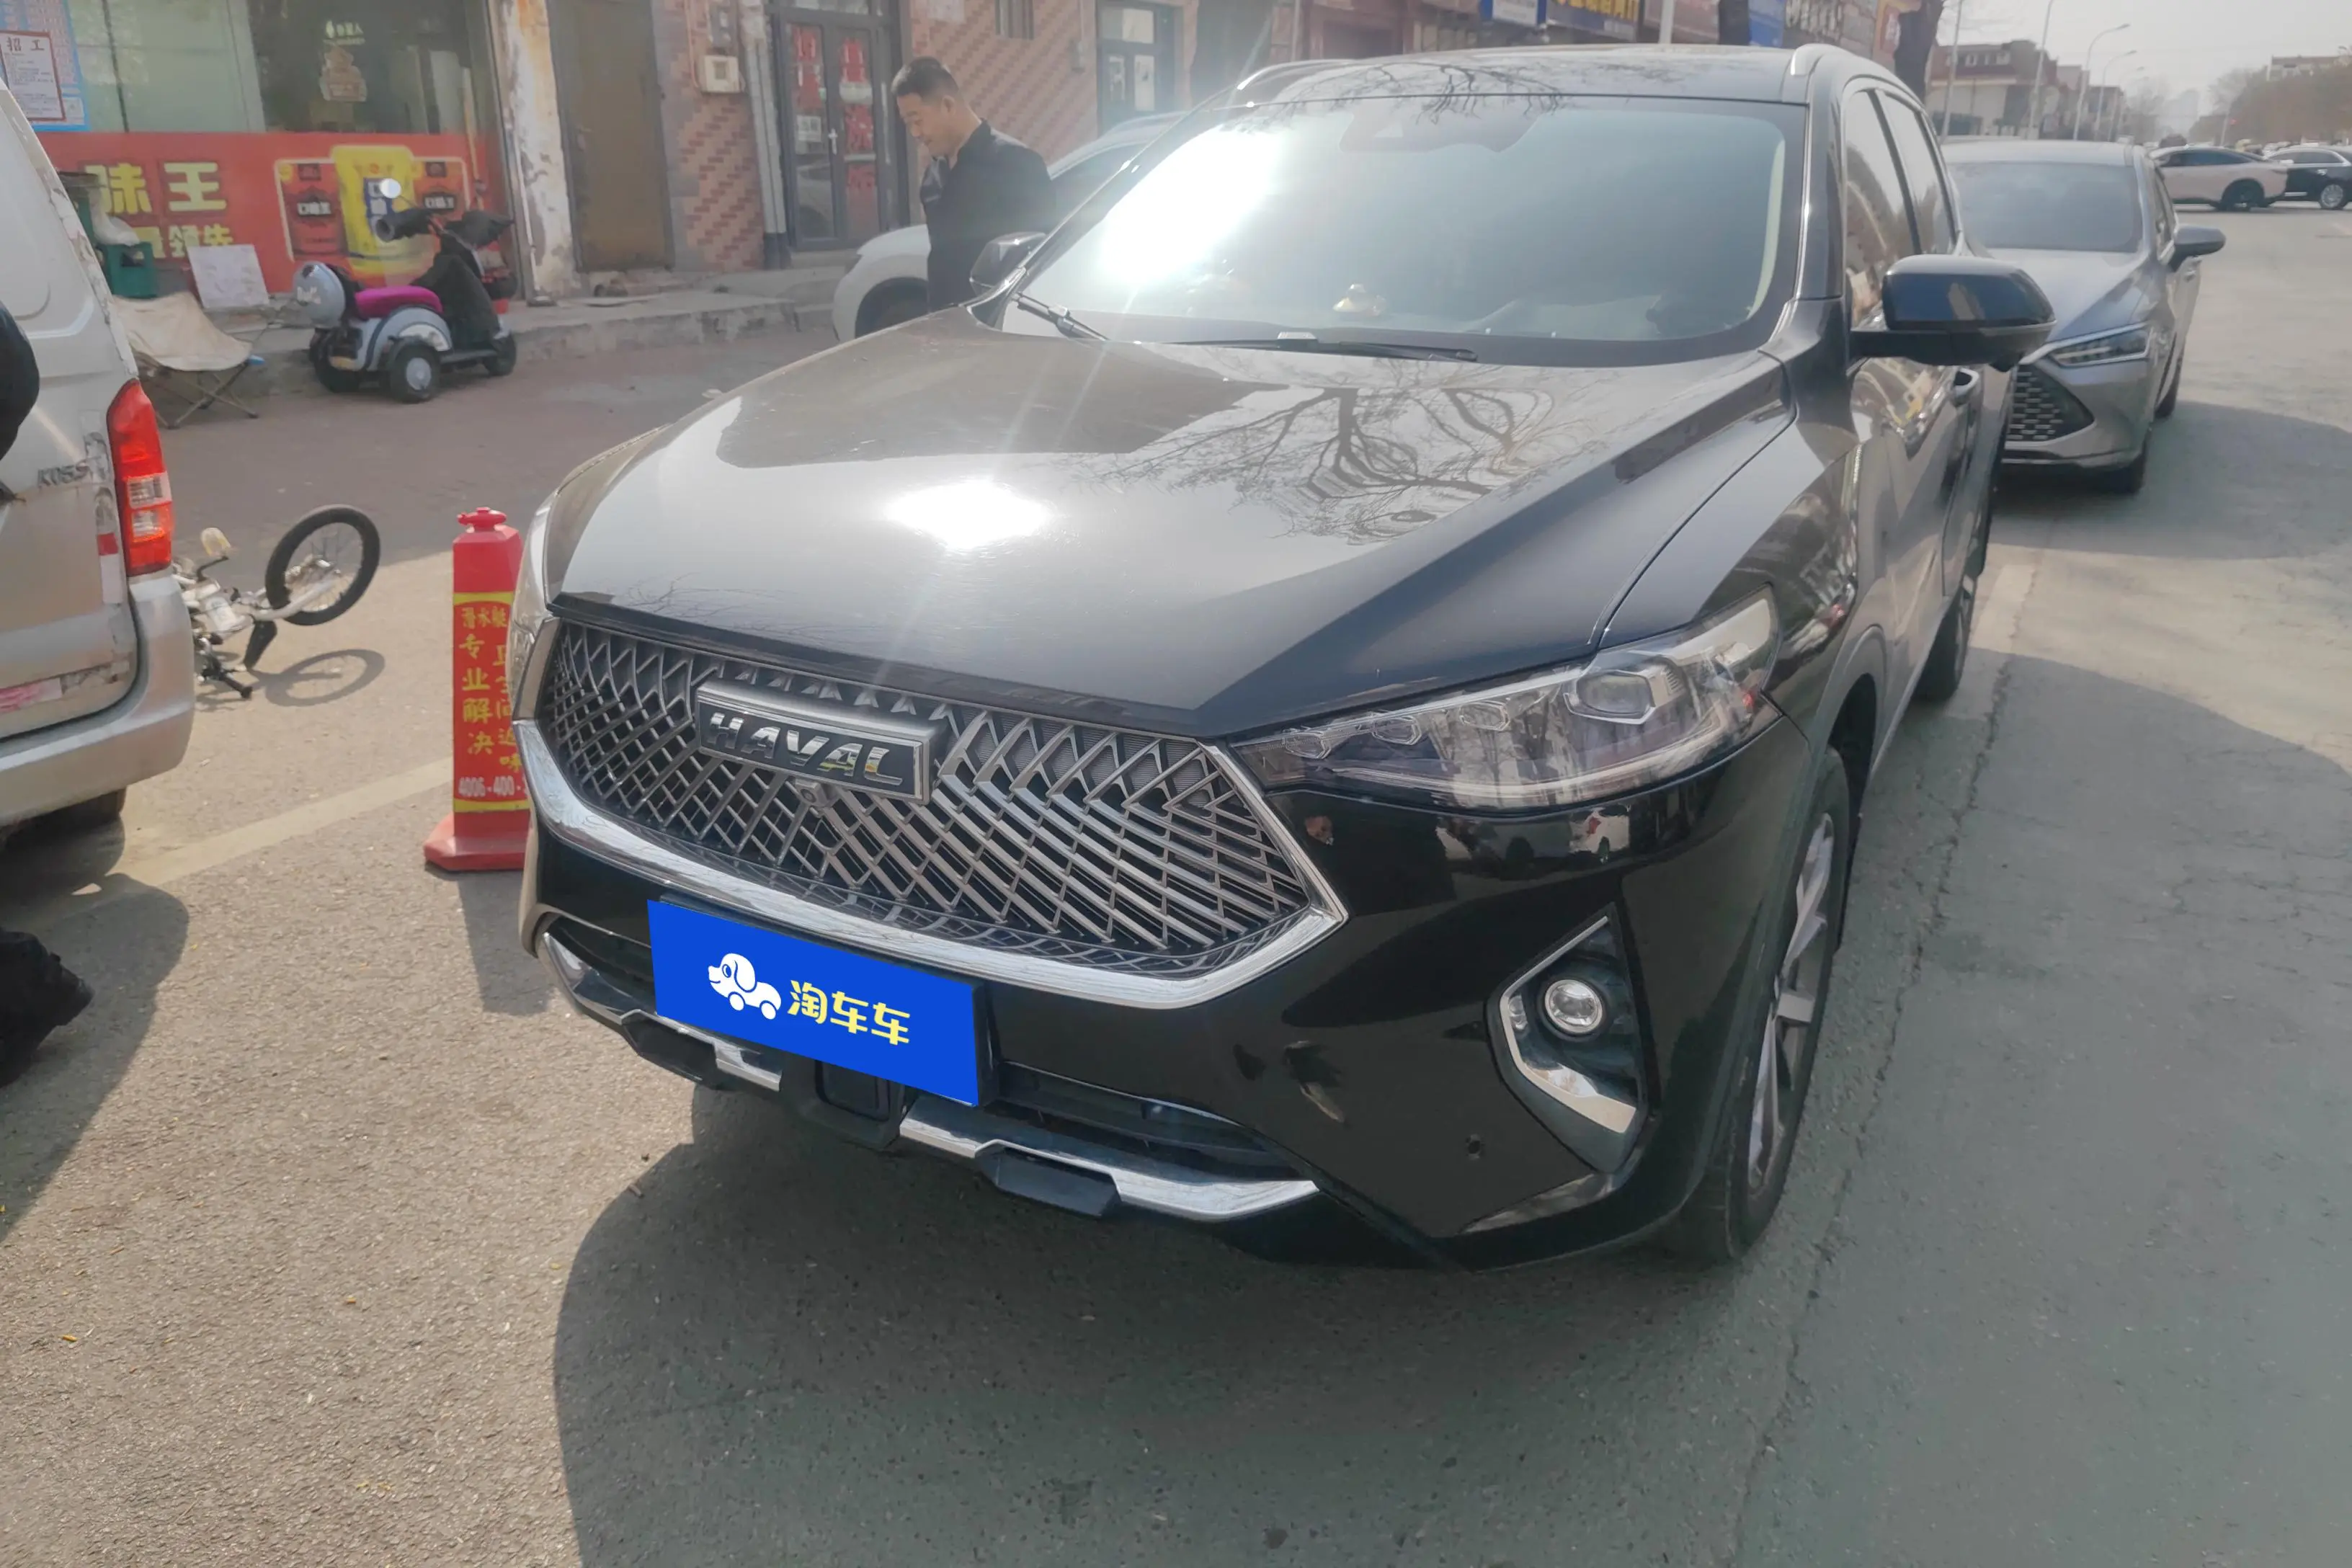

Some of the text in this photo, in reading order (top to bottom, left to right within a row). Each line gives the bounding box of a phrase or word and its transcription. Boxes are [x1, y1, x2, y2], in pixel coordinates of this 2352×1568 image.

[6, 37, 45, 51] 招工
[458, 633, 494, 755] 专业解决
[709, 712, 903, 786] HAVAL
